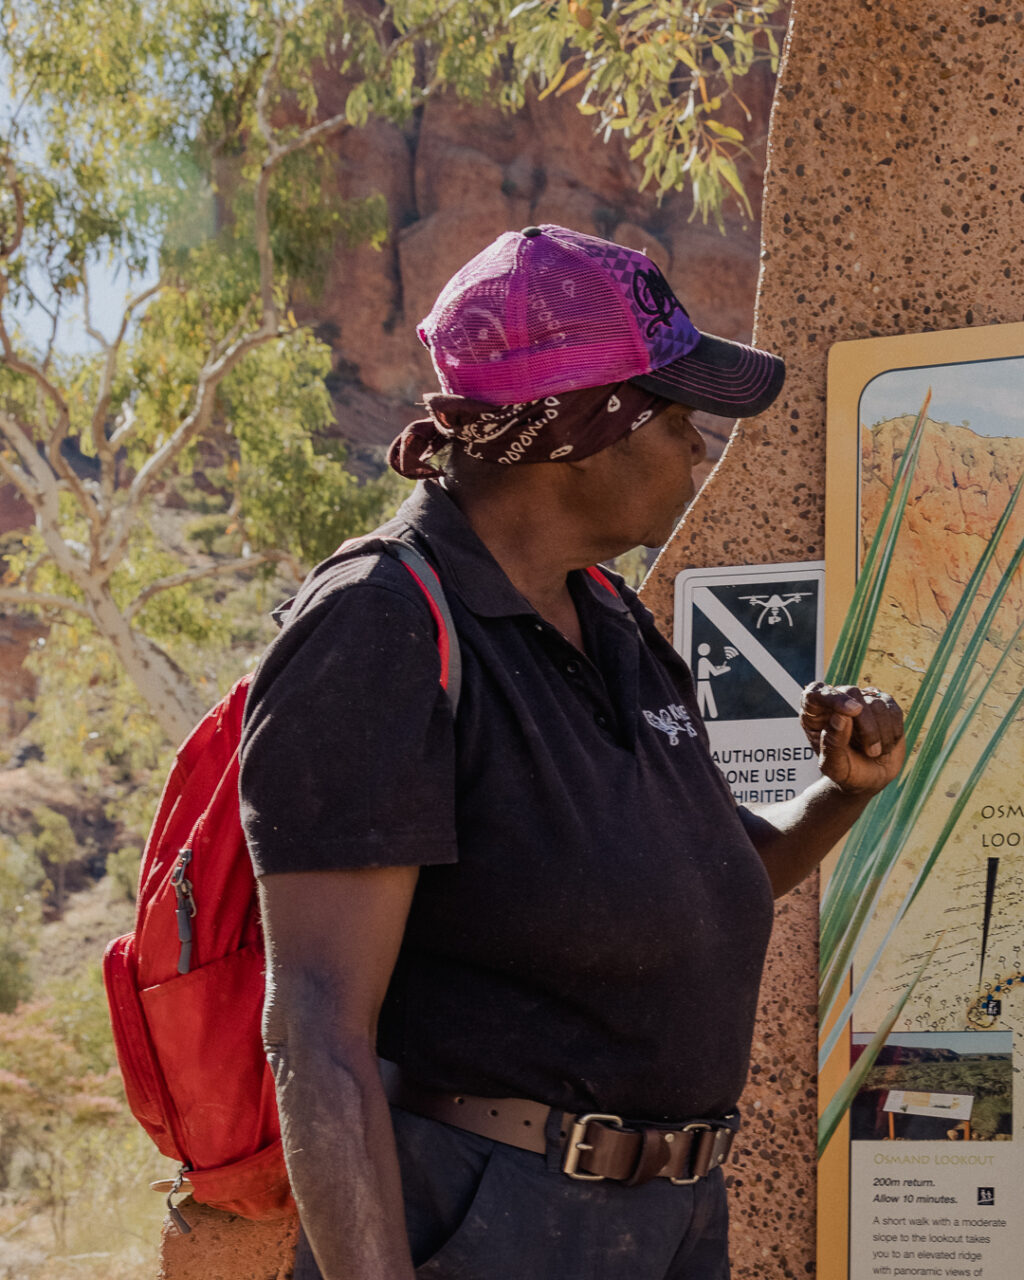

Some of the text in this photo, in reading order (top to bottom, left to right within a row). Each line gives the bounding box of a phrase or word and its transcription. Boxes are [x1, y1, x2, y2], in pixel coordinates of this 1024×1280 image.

[712, 747, 814, 764] AUTHORISED
[765, 768, 797, 782] USE
[873, 1152, 995, 1166] OSMAND LOOKOUT
[872, 1177, 936, 1187] 200m return.
[872, 1194, 958, 1204] Allow 10 minutes.
[872, 1216, 1007, 1227] A short walk with a moderate
[872, 1233, 991, 1244] slope to the lookout takes
[872, 1250, 983, 1262] you to an elevated ridge
[872, 1266, 983, 1277] with panoramic views of
